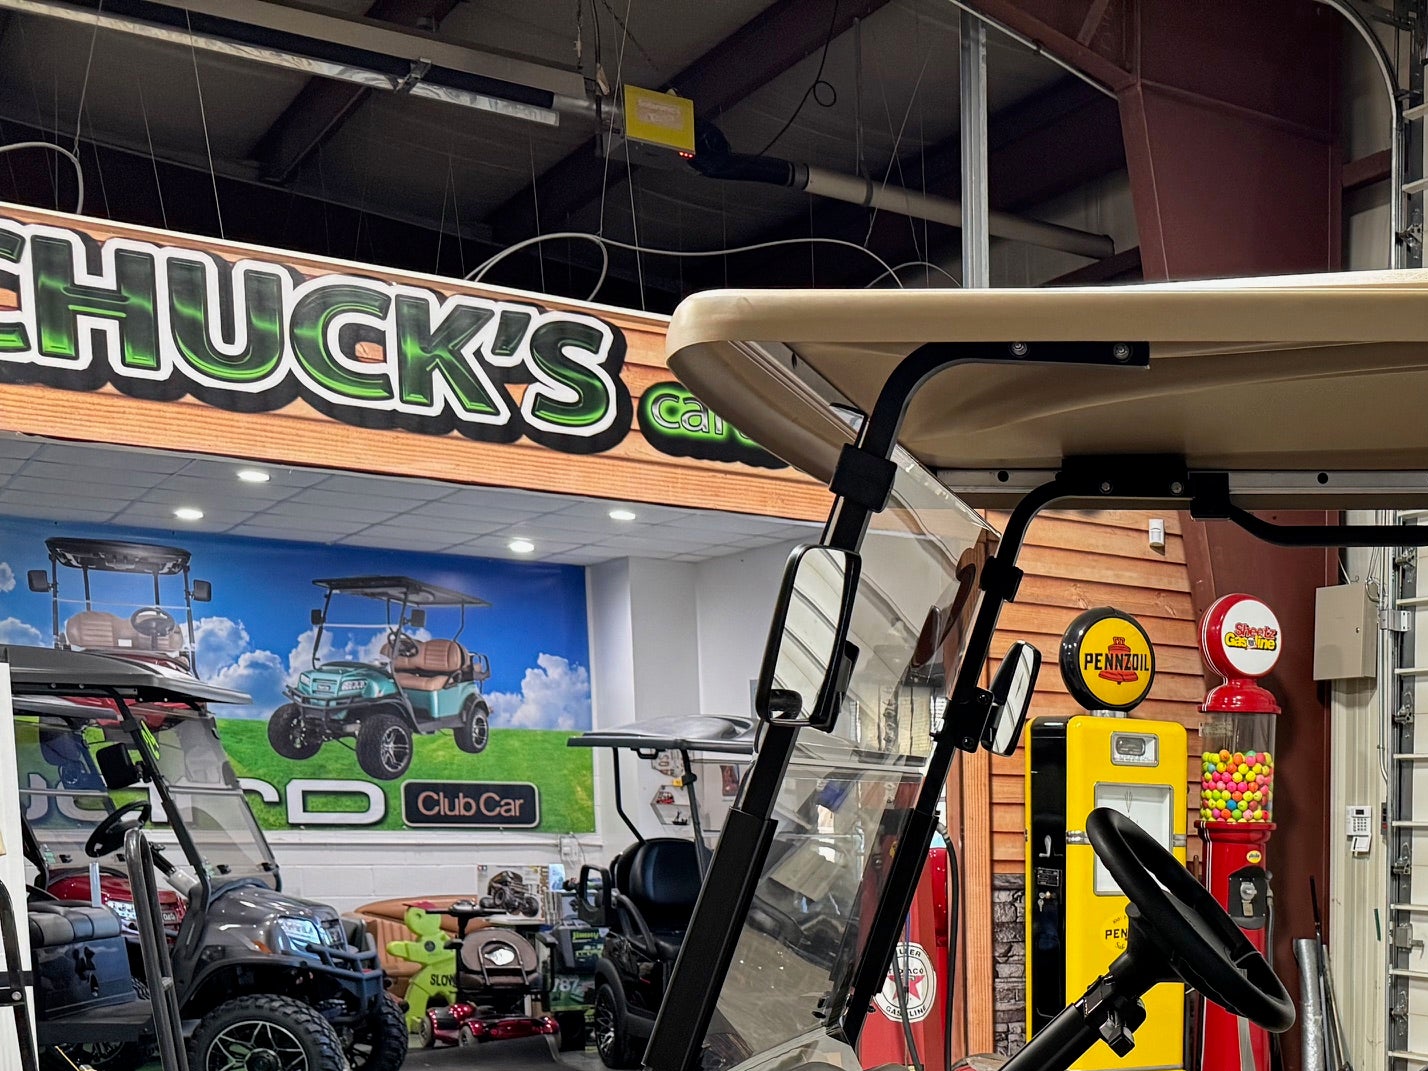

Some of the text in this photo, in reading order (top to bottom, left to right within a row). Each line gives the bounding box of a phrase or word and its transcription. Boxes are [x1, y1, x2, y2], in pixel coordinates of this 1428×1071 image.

[1084, 652, 1149, 671] PENNZOIL
[417, 791, 524, 817] Club Car
[885, 1004, 927, 1018] GASLINE
